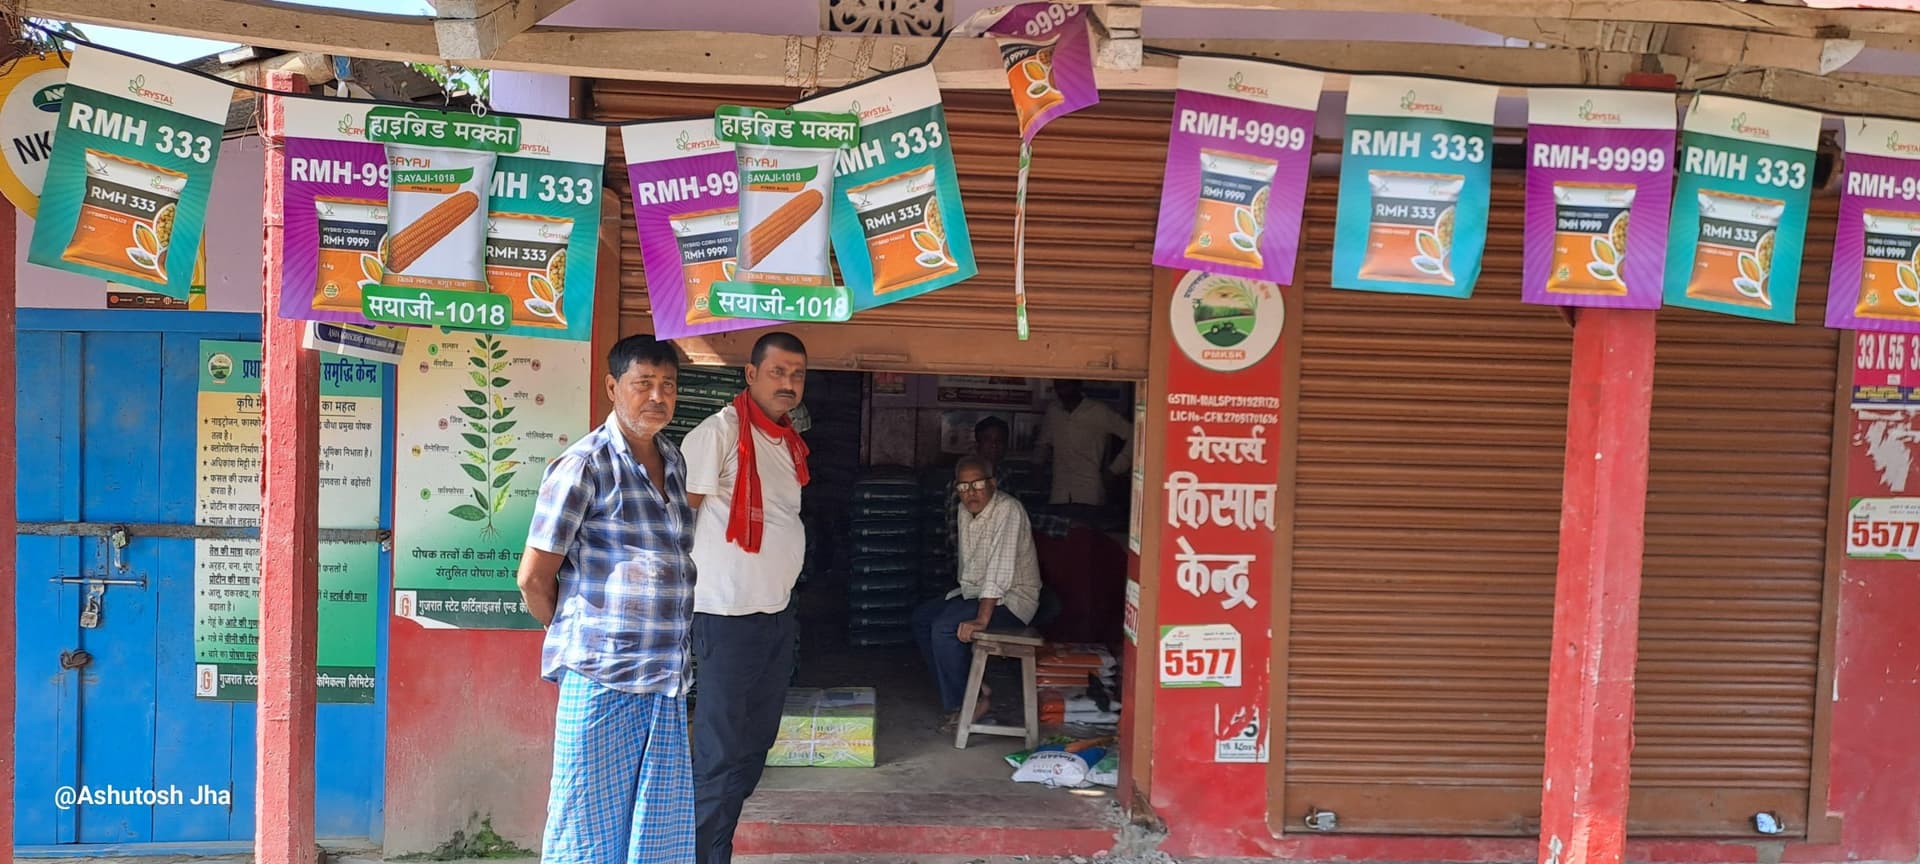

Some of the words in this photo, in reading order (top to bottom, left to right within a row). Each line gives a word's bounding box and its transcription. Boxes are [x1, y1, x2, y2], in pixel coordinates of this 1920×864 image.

[137, 88, 174, 104] CRYSTAL
[859, 105, 893, 120] CRYSTAL
[68, 102, 147, 146] RMH
[155, 126, 212, 164] 333
[369, 111, 448, 140] हाइब्रिड
[453, 122, 516, 145] मक्का
[719, 111, 795, 140] हाइब्रिड
[799, 120, 857, 142] मक्का
[1179, 109, 1305, 151] RMH-9999
[12, 130, 52, 164] NK
[686, 139, 720, 150] CRYSTAL
[834, 138, 886, 177] MH
[891, 121, 944, 159] 333
[1350, 129, 1421, 158] RMH
[1430, 133, 1485, 163] 333
[1533, 143, 1665, 172] RMH-9999
[397, 173, 455, 183] SAYAJI-1018
[747, 172, 800, 183] SAYAJI-1018
[1685, 147, 1748, 181] RMH
[1755, 157, 1806, 190] 333
[90, 186, 127, 206] RMH
[130, 196, 157, 213] 333
[538, 174, 593, 205] 333
[1203, 186, 1223, 198] RMH
[1225, 189, 1246, 201] 9999
[865, 212, 897, 231] RMH
[899, 203, 922, 222] 333
[1375, 203, 1407, 217] RMH
[1410, 205, 1437, 219] 333
[1558, 218, 1578, 229] RMH
[1579, 220, 1602, 231] 9999
[323, 234, 344, 246] RMH
[347, 236, 370, 248] 9999
[1702, 223, 1732, 240] RMH
[1733, 227, 1758, 243] 333
[487, 246, 518, 260] RMH
[522, 248, 547, 262] 333
[684, 248, 705, 260] RMH
[707, 246, 728, 258] 9999
[1867, 245, 1885, 256] RMH
[1887, 246, 1905, 258] 9999
[366, 292, 505, 326] सयाजी-1018
[717, 288, 848, 318] सयाजी-1018
[1857, 334, 1875, 370] 33
[1876, 334, 1886, 370] X
[1887, 334, 1905, 370] 55
[355, 358, 377, 383] केन्द्र
[321, 401, 332, 411] का
[1187, 425, 1267, 464] मेसर्स
[1164, 471, 1277, 531] किसान
[1852, 521, 1919, 548] 5577
[412, 547, 437, 559] पोषक
[462, 547, 474, 560] की
[476, 548, 496, 560] कमी
[498, 549, 511, 561] की
[470, 565, 494, 578] पोषण
[497, 566, 509, 578] को
[1175, 536, 1258, 610] केन्द्र
[418, 600, 442, 616] गुजरात
[445, 596, 459, 612] स्टेट
[1165, 648, 1236, 677] 5577
[220, 673, 242, 689] गुजरात
[348, 673, 375, 689] लिमिटेड
